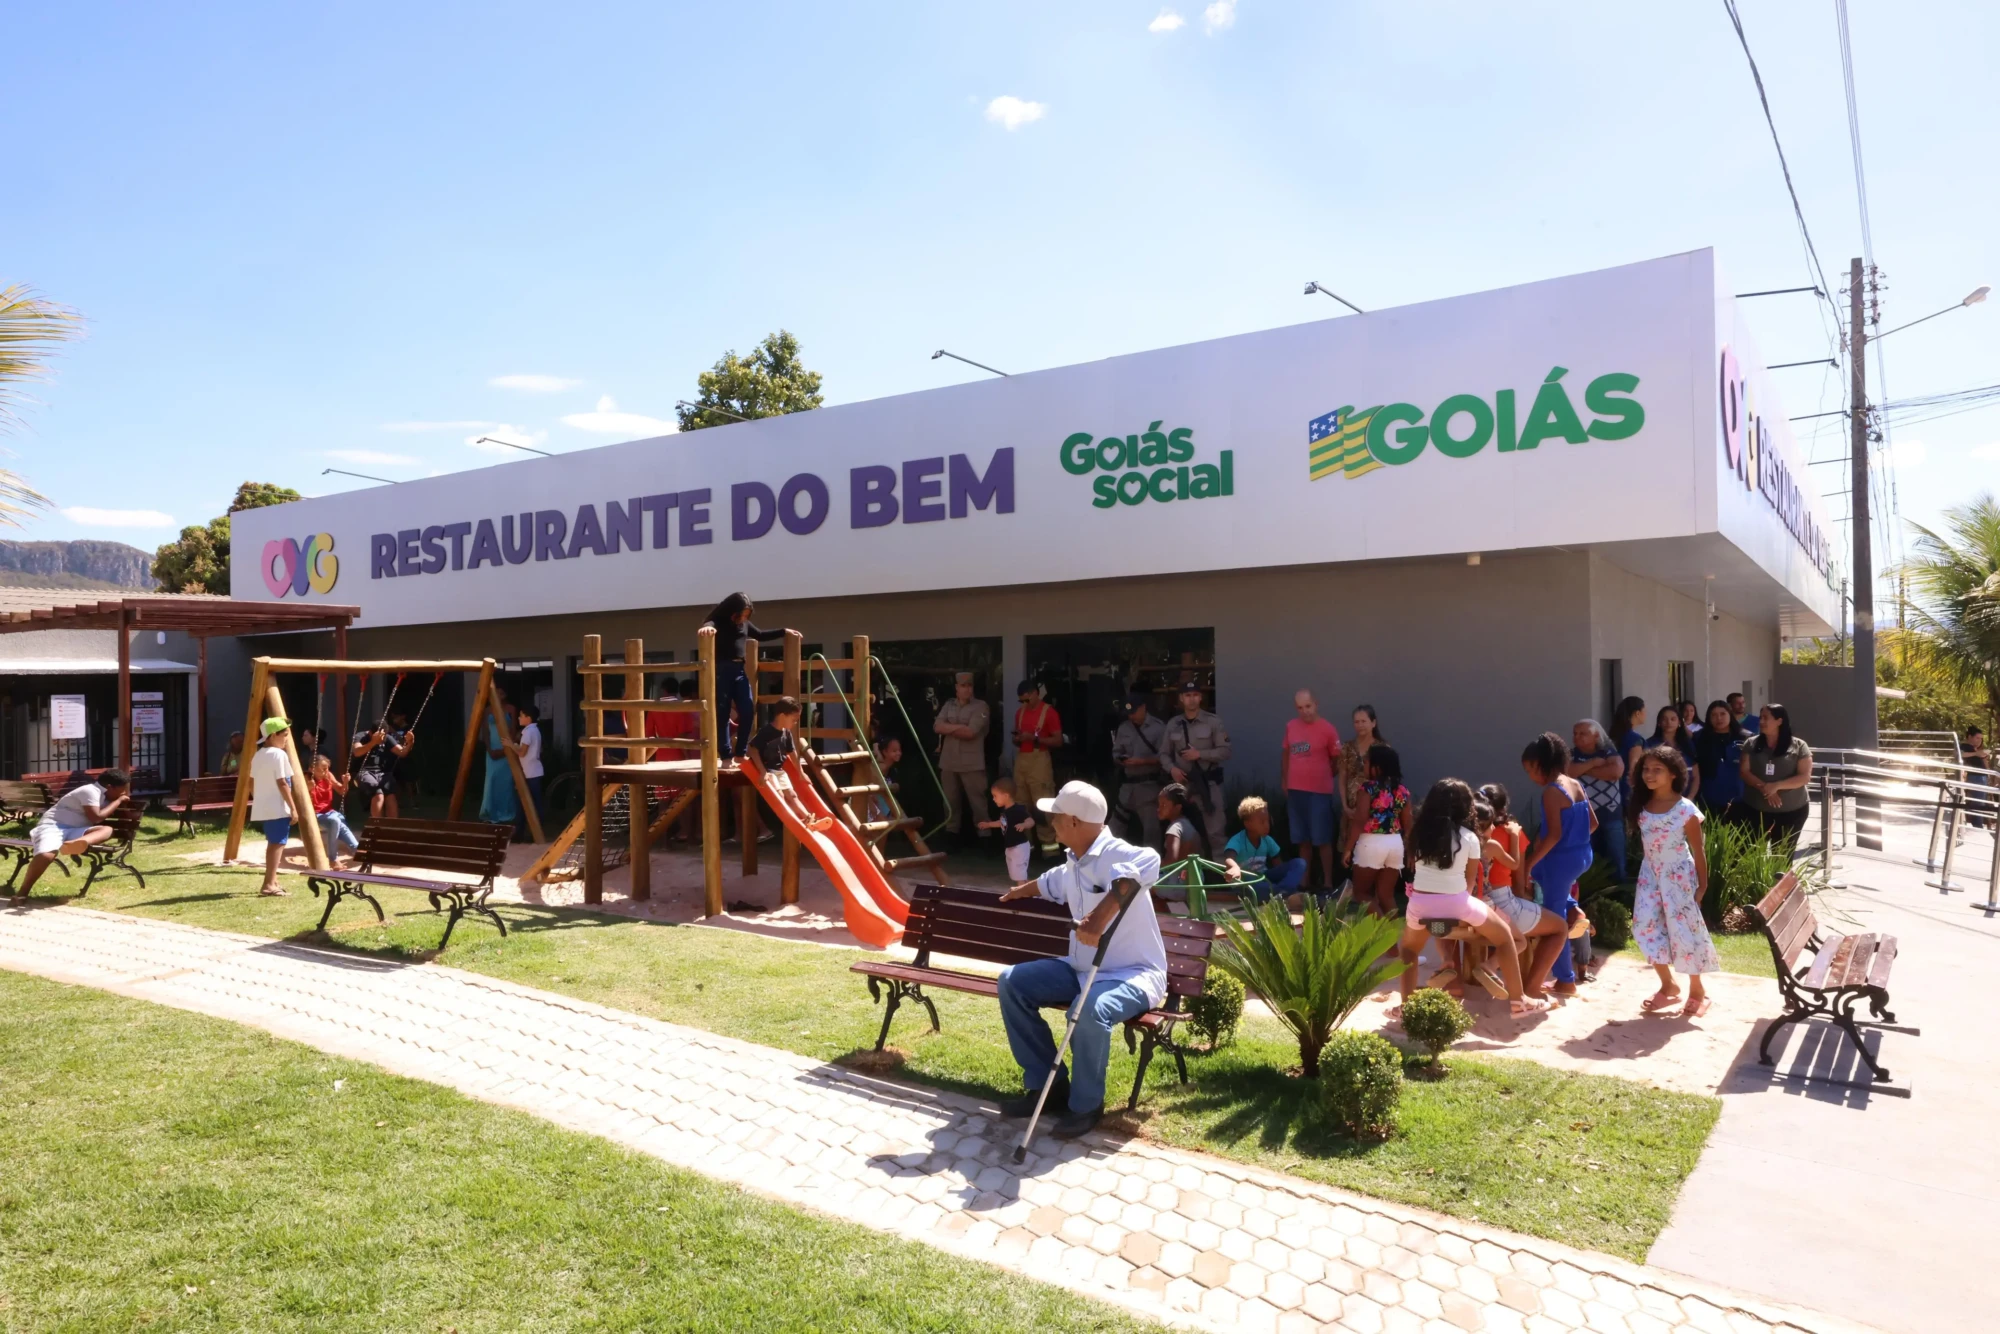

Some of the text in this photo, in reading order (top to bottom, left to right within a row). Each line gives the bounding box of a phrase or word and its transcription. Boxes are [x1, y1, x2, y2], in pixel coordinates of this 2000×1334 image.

[1059, 420, 1195, 476] Goiás
[1366, 366, 1646, 466] GOIÁS
[371, 446, 1015, 580] RESTAURANTE DO BEM
[1091, 449, 1234, 509] social
